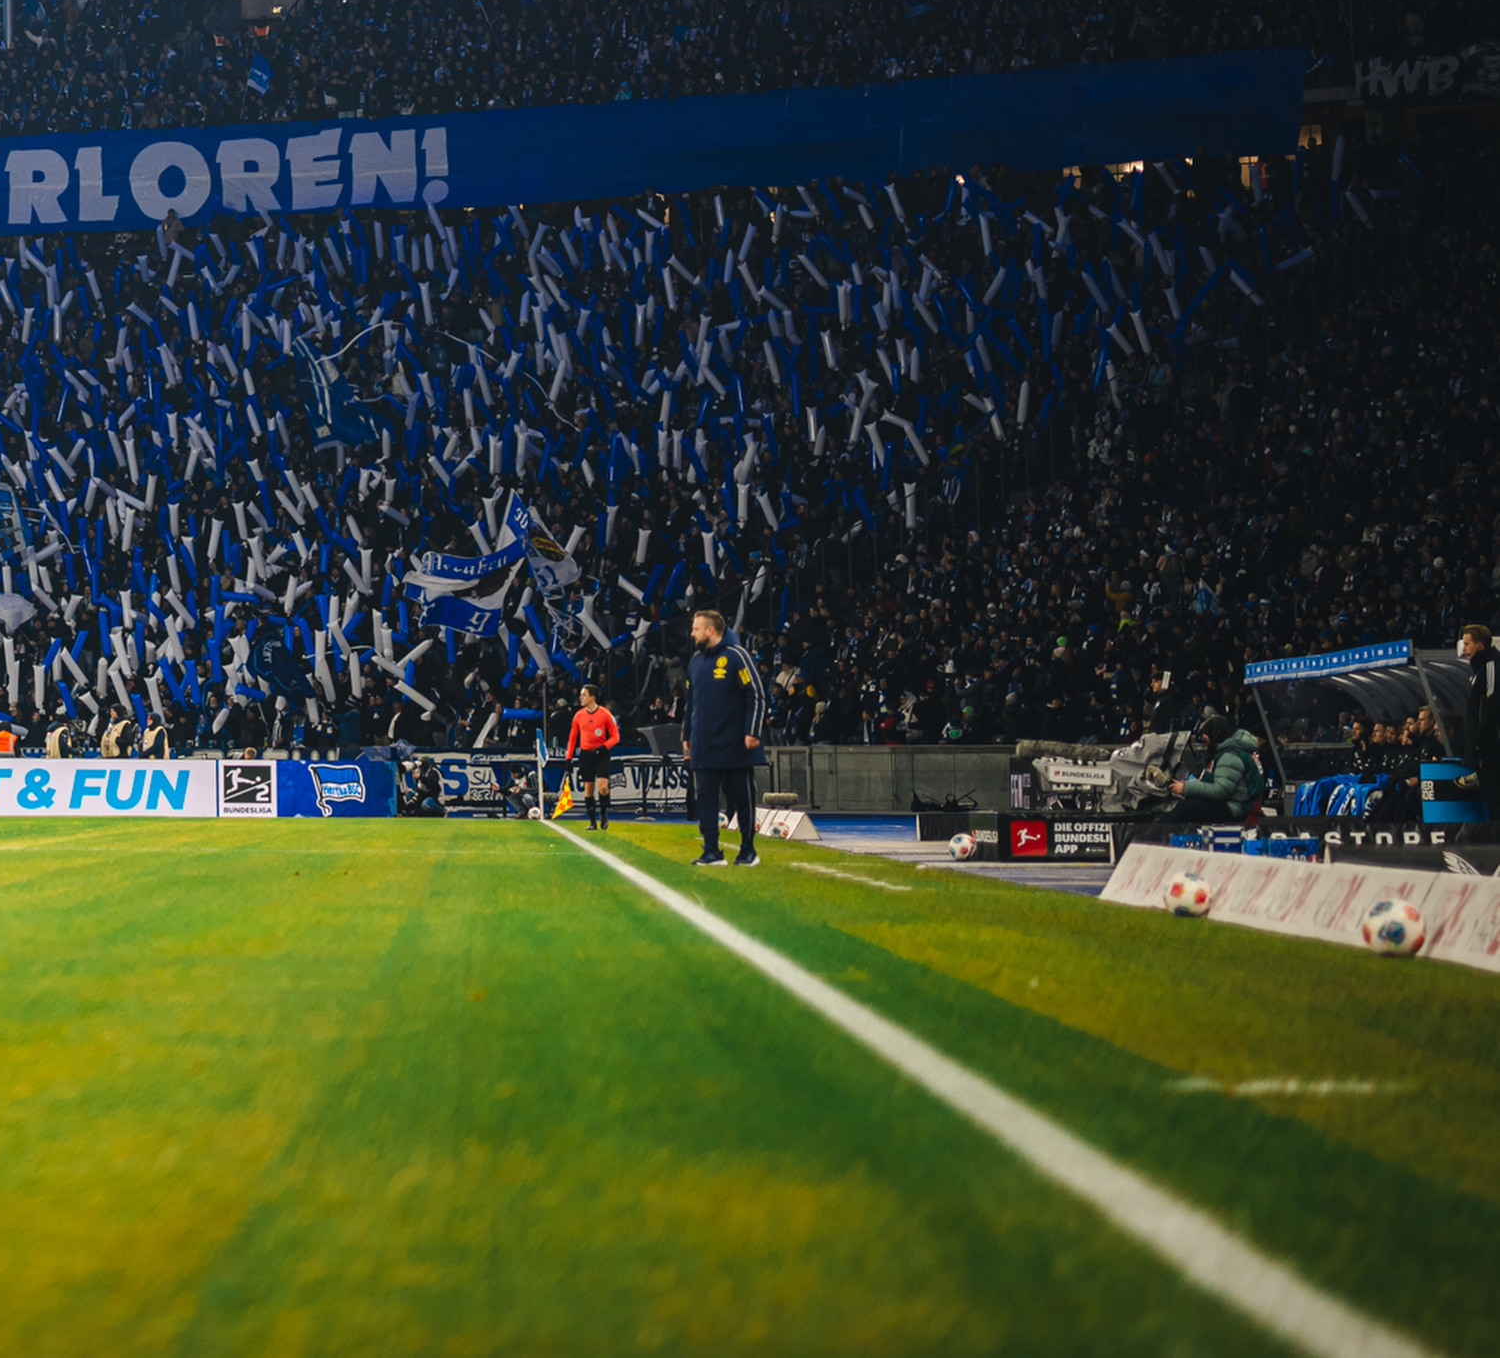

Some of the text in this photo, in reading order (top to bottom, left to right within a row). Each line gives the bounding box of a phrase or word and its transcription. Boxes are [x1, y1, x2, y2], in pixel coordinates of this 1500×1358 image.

[1061, 770, 1105, 780] BUNDESLIGA
[16, 767, 58, 809] &
[69, 769, 190, 810] FUN
[1054, 823, 1073, 832] DIE
[1054, 844, 1078, 854] APP
